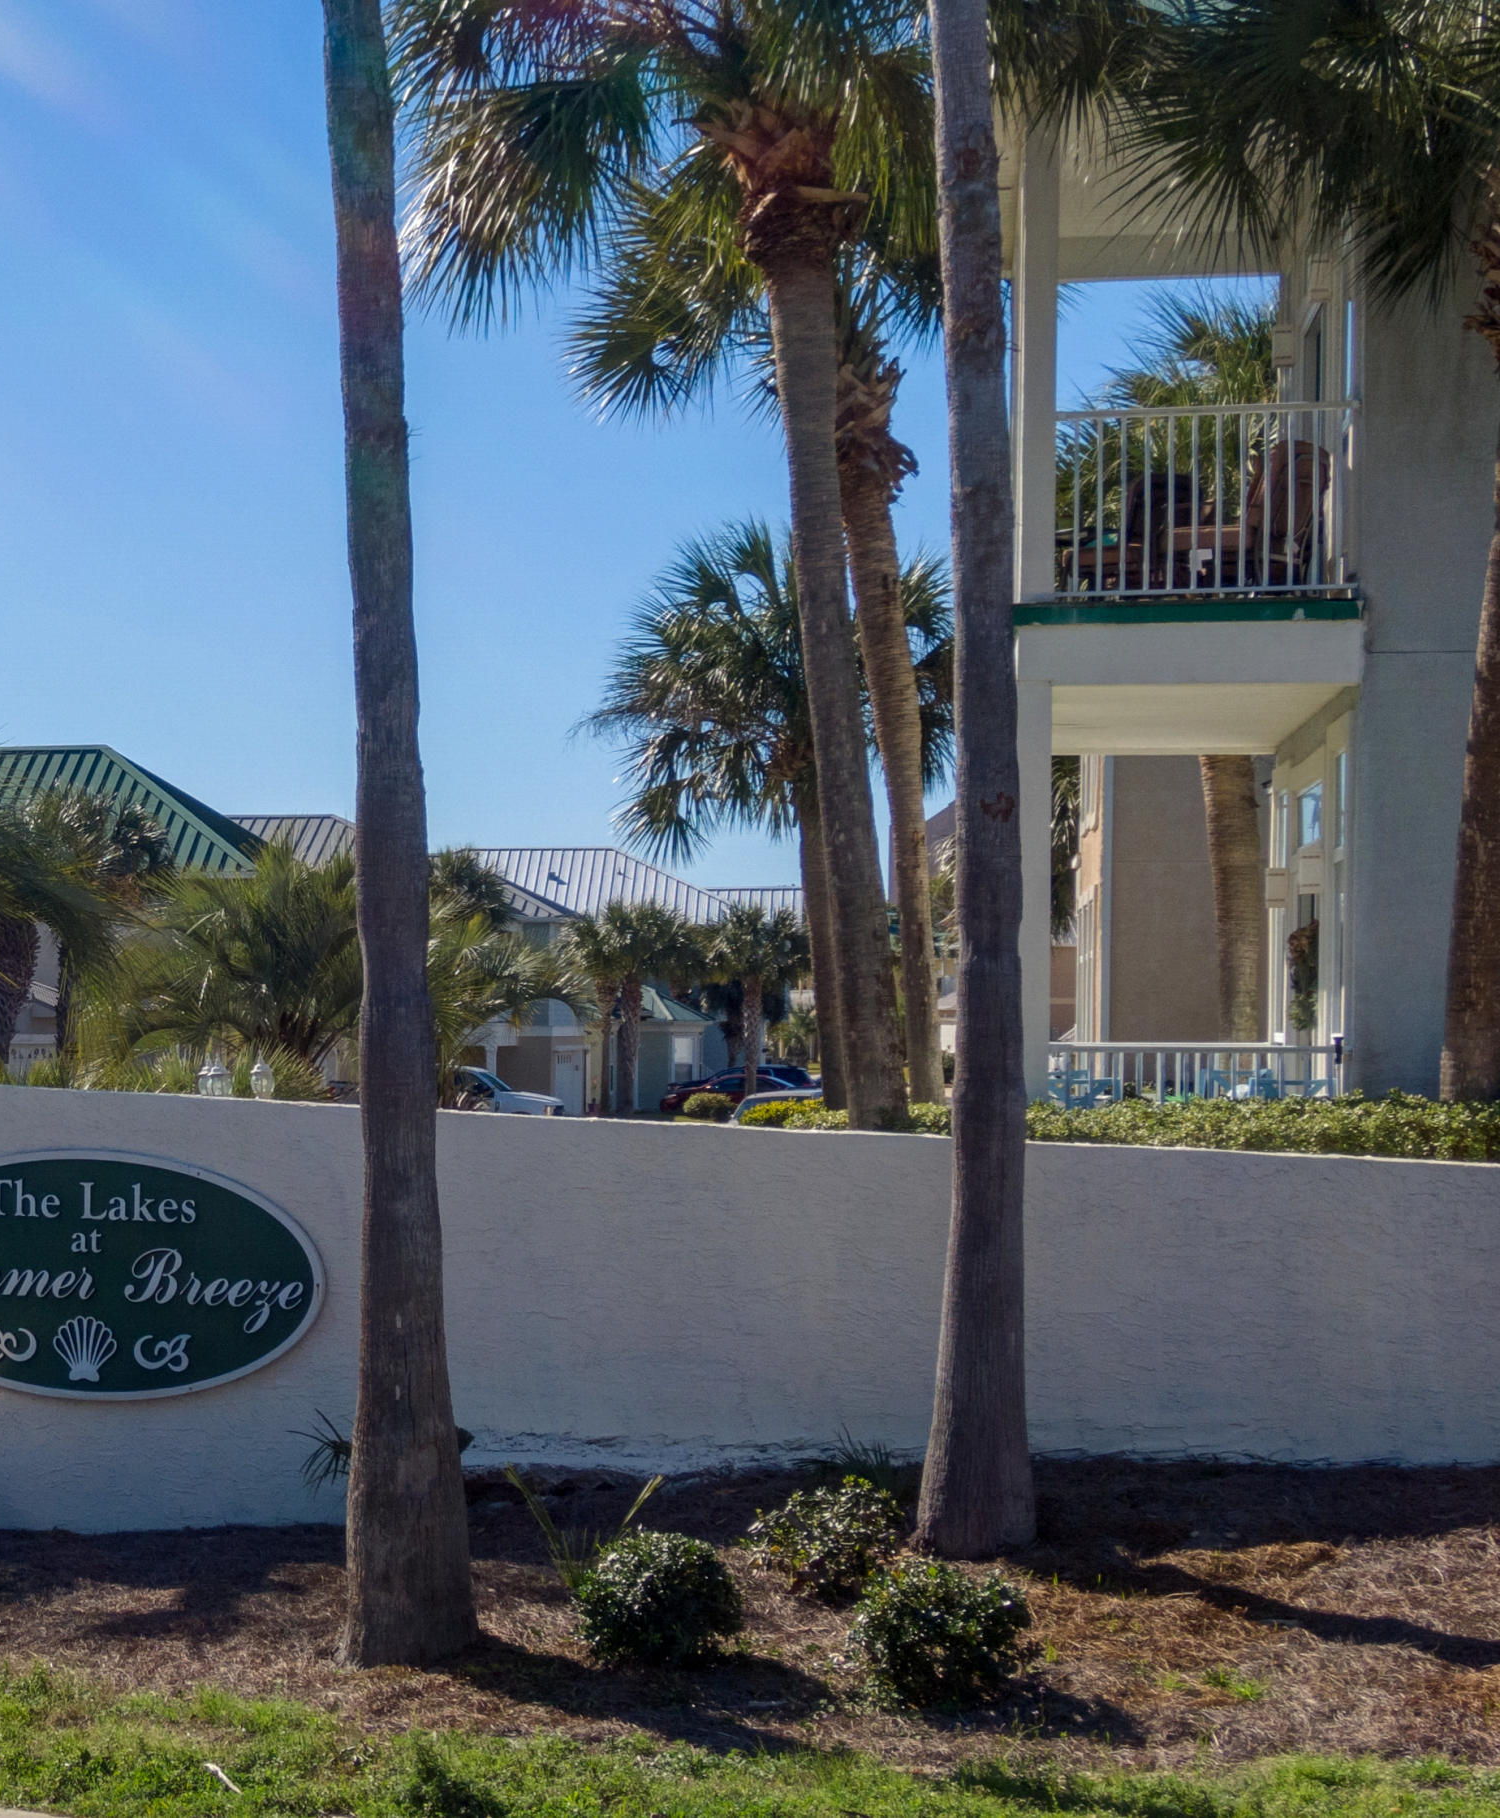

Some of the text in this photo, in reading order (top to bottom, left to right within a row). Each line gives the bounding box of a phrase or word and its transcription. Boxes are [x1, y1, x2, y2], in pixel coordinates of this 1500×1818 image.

[80, 1182, 197, 1224] Lakes
[71, 1229, 102, 1253] at
[124, 1248, 304, 1334] Breeze
